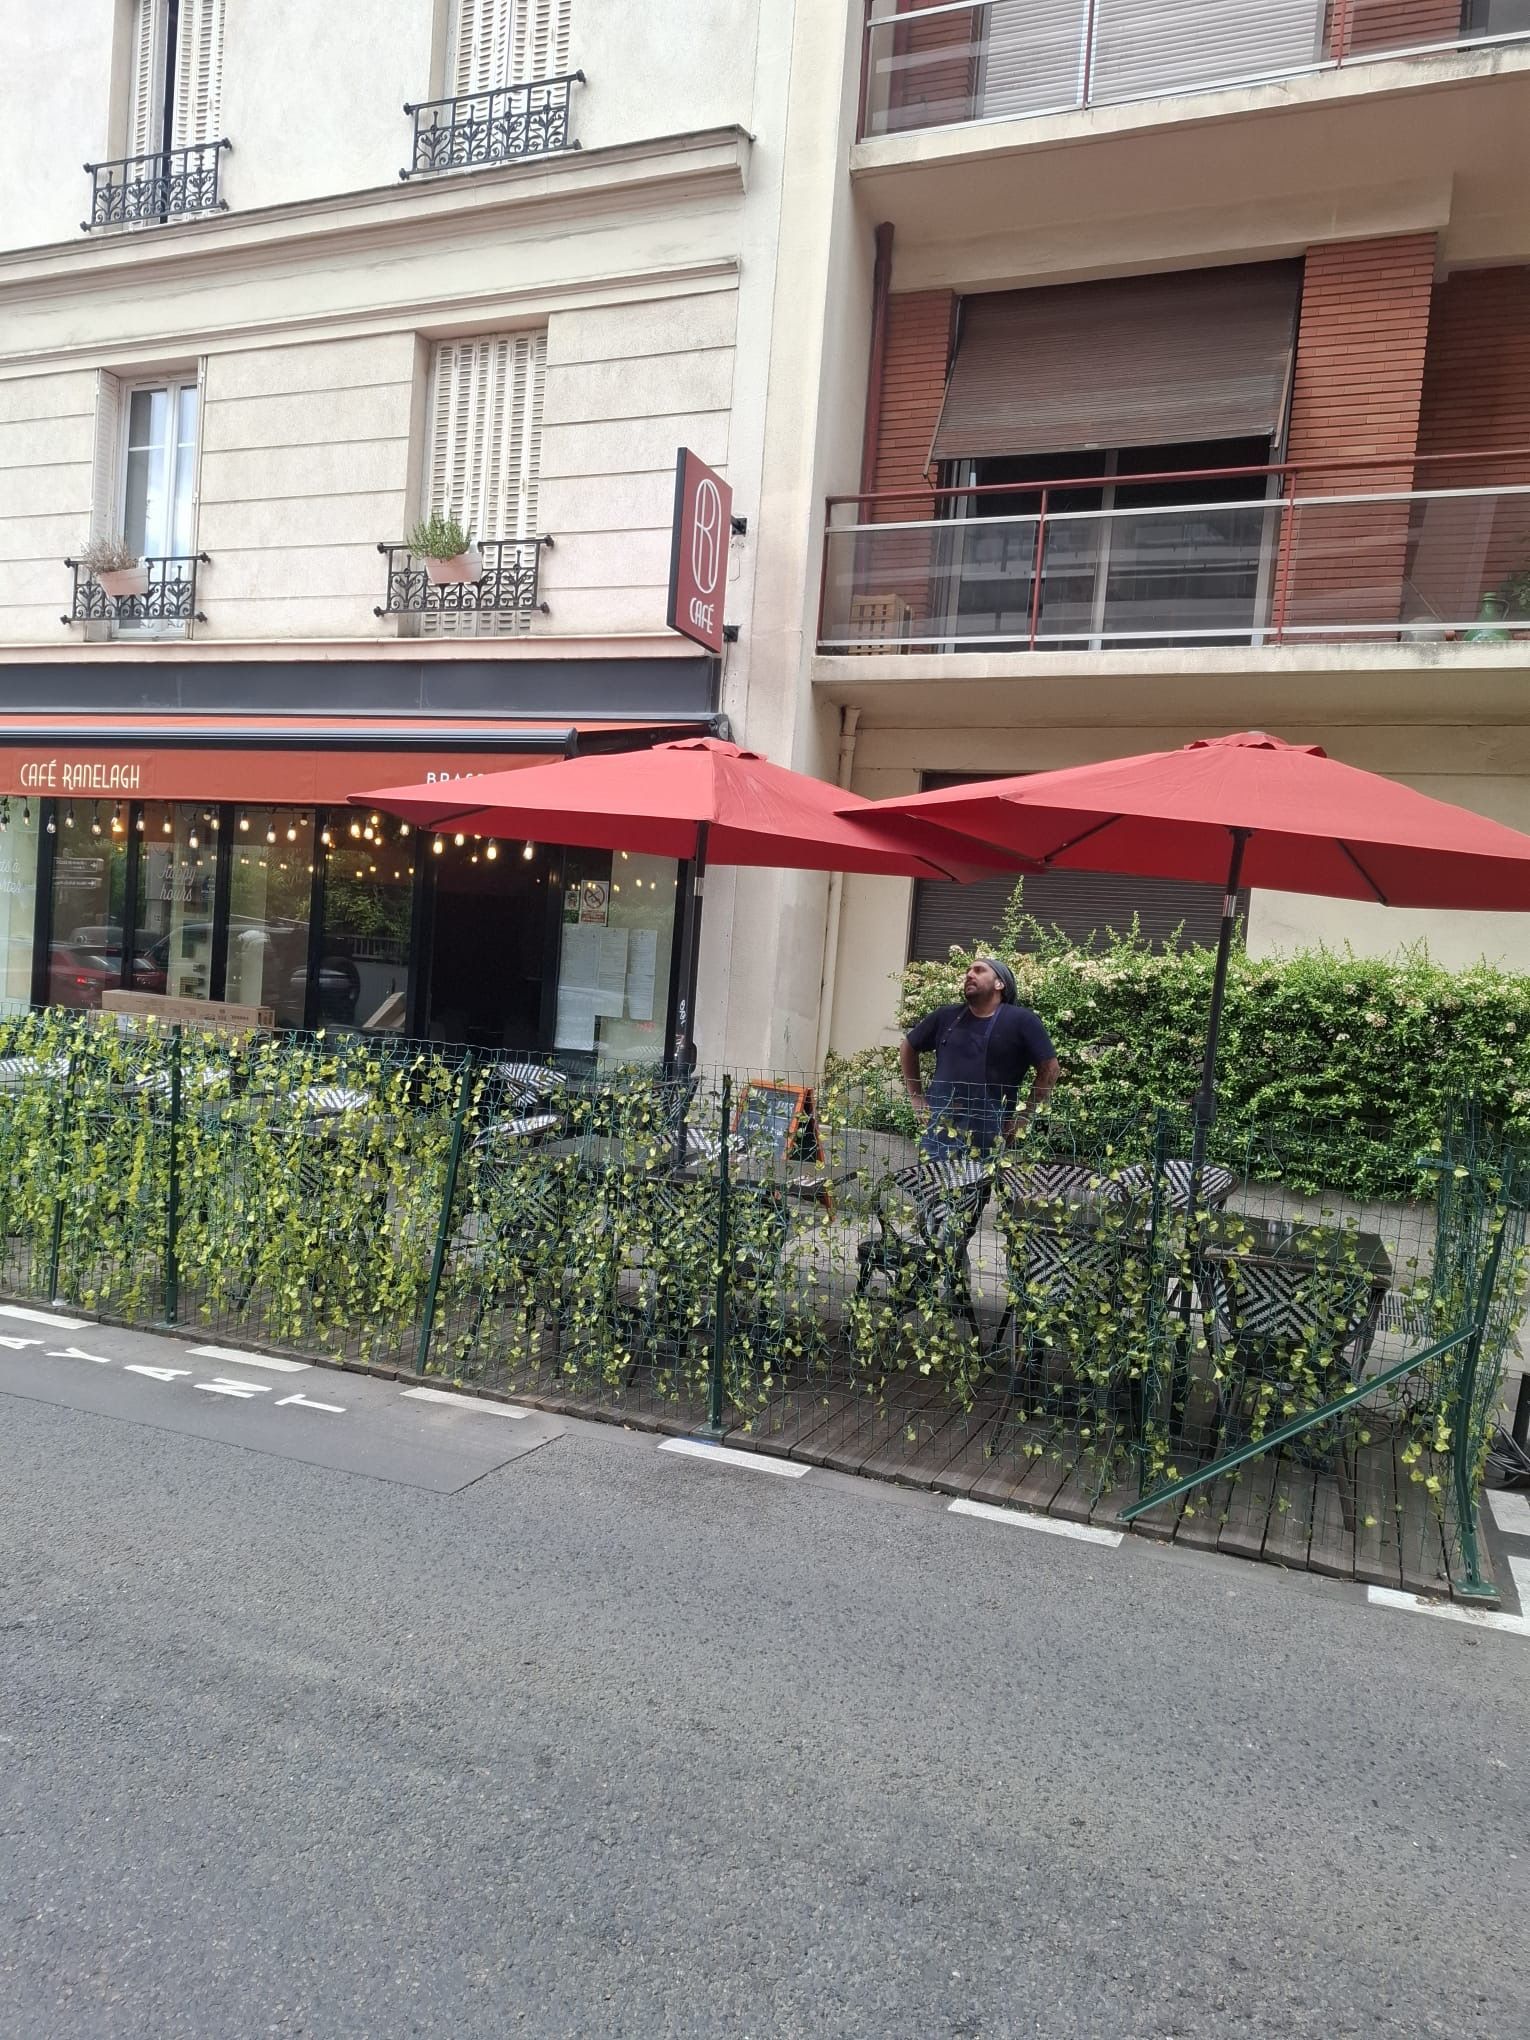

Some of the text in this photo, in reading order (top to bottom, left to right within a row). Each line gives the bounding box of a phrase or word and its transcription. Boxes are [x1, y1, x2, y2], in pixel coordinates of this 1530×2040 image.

[690, 597, 714, 634] CAFÉ
[20, 759, 140, 790] CAFÉ RANELAGH
[160, 882, 193, 902] hours
